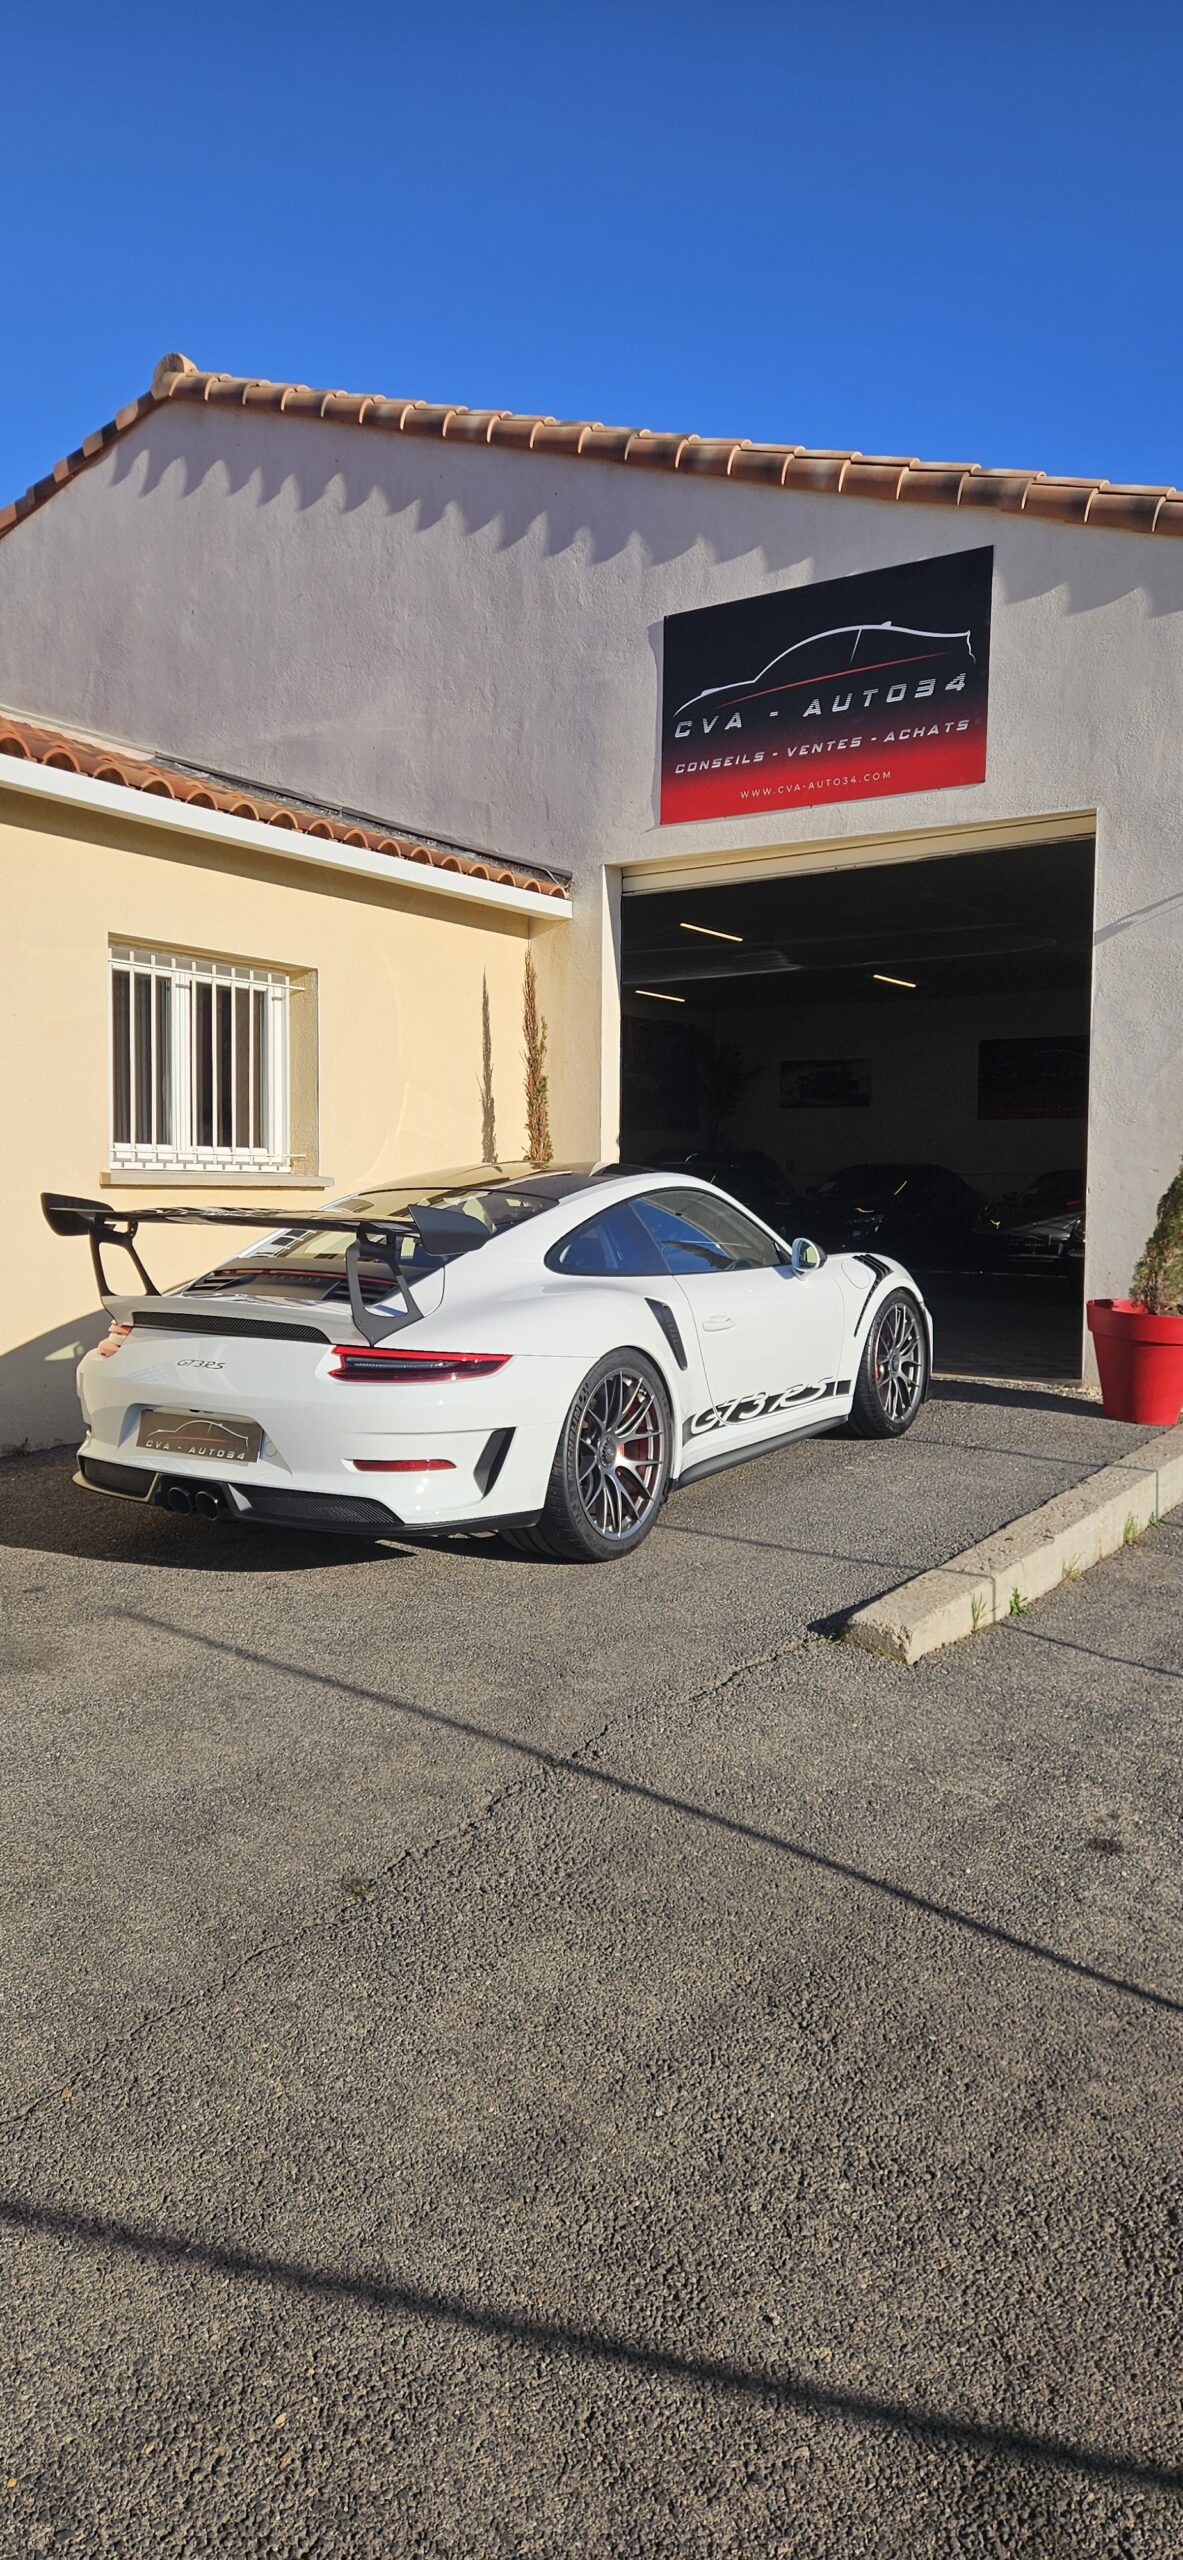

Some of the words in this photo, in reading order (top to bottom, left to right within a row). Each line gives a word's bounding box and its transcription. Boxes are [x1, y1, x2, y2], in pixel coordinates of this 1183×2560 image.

[674, 712, 743, 738] CVA
[803, 672, 967, 718] AUTO34
[674, 751, 765, 774] CONSEILS
[787, 736, 863, 757] VENTES
[883, 719, 970, 743] ACHATS
[740, 771, 892, 799] WWW.CVA-AUTO34.COM
[145, 1440, 170, 1450] CVA
[188, 1446, 245, 1460] AUTO34
